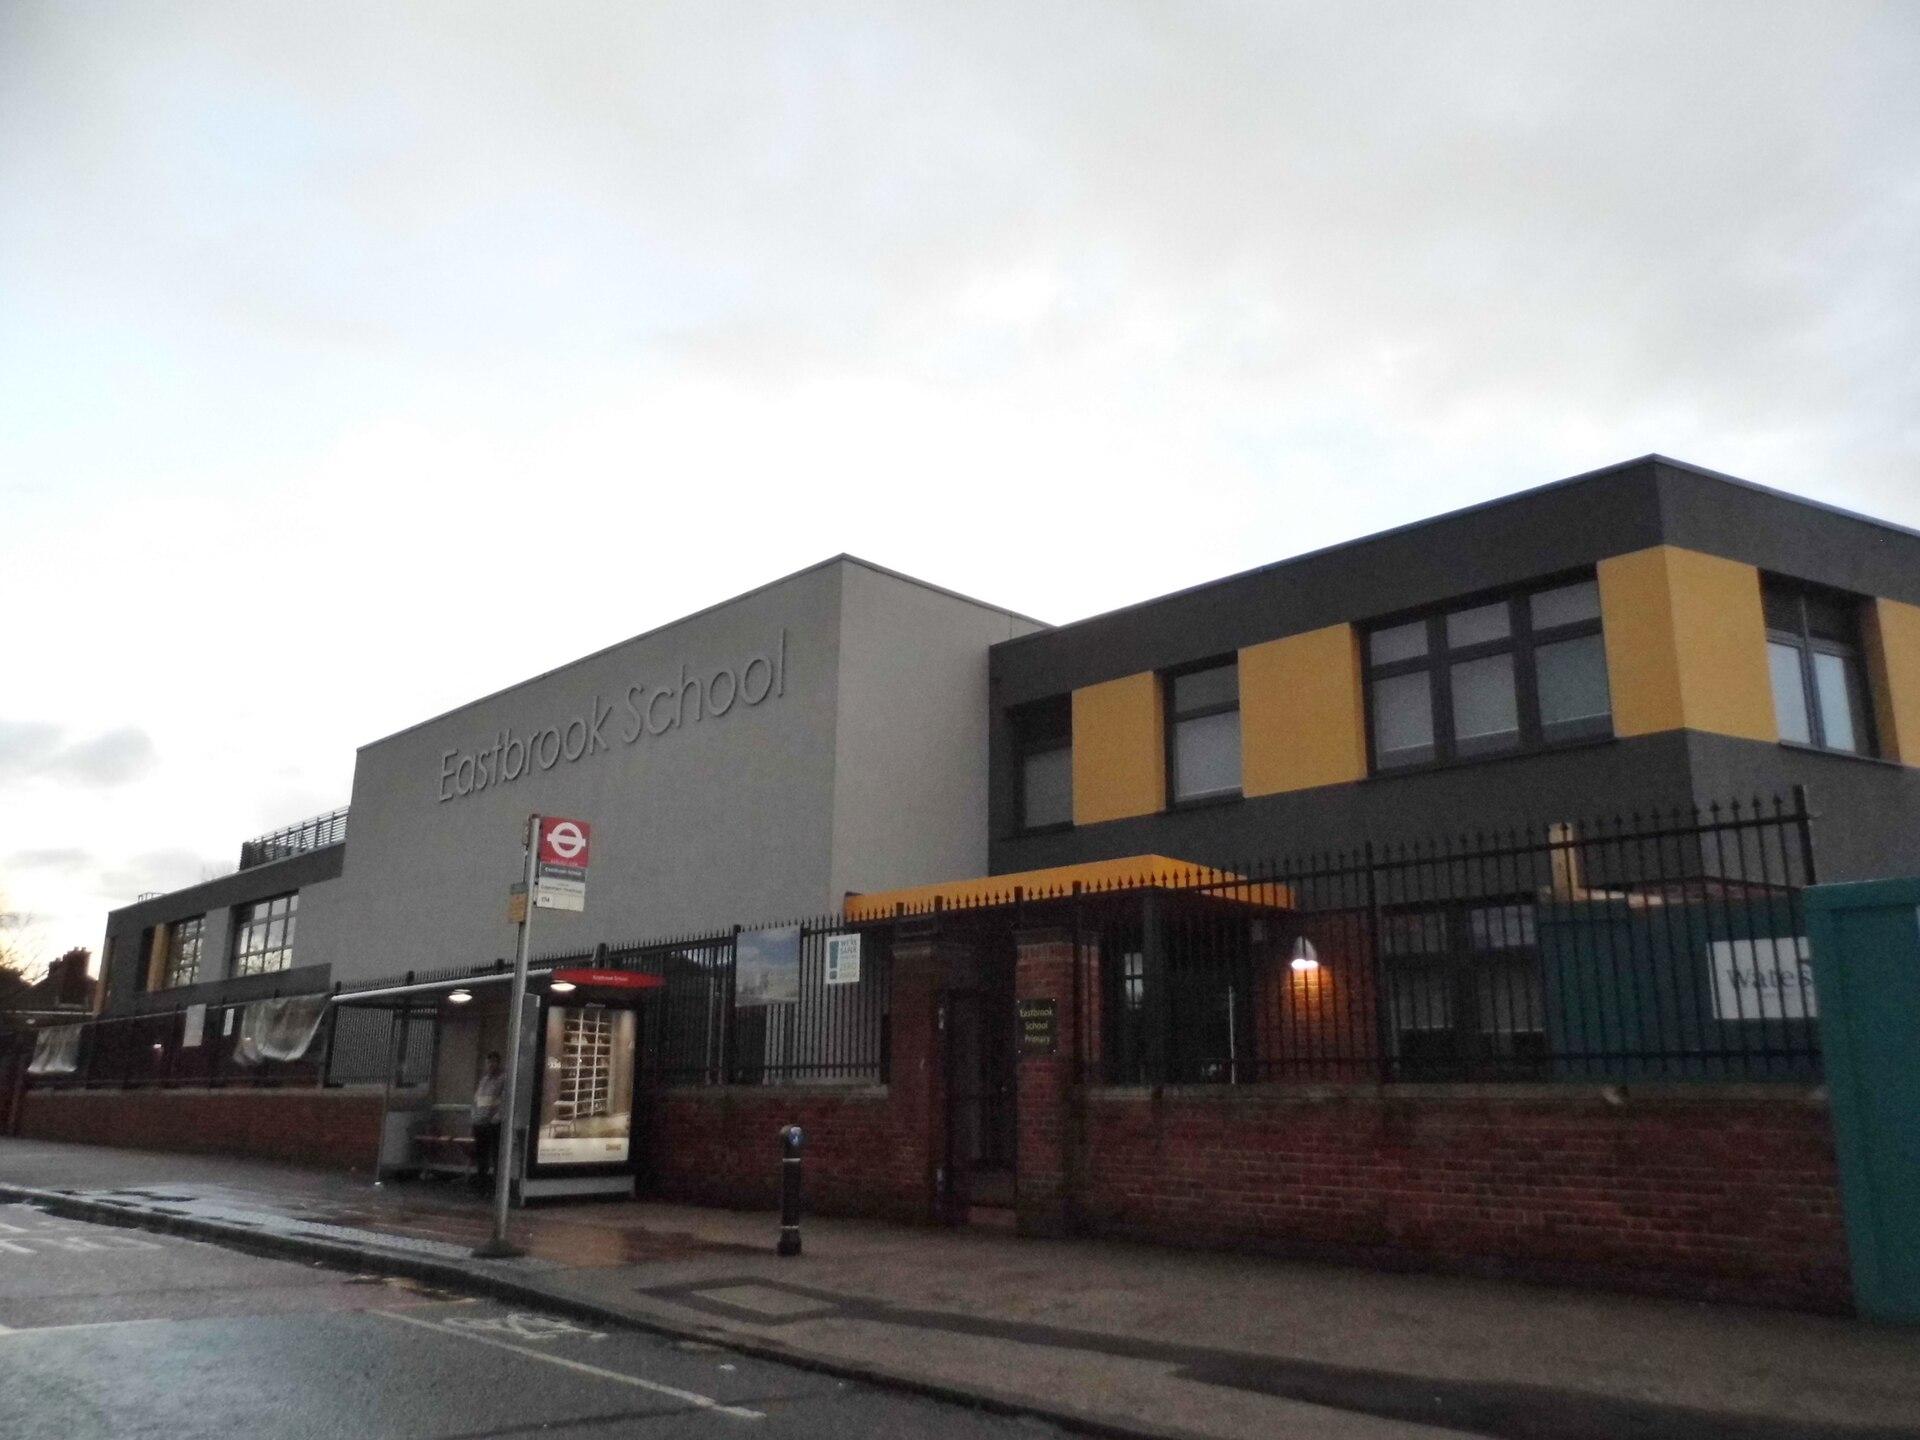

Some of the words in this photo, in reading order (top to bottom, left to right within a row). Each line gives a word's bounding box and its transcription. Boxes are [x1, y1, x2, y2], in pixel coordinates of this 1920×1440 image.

[438, 695, 616, 803] Eastbrook
[622, 627, 787, 745] School
[1019, 1007, 1052, 1018] Eastbrook
[1025, 1021, 1048, 1031] School
